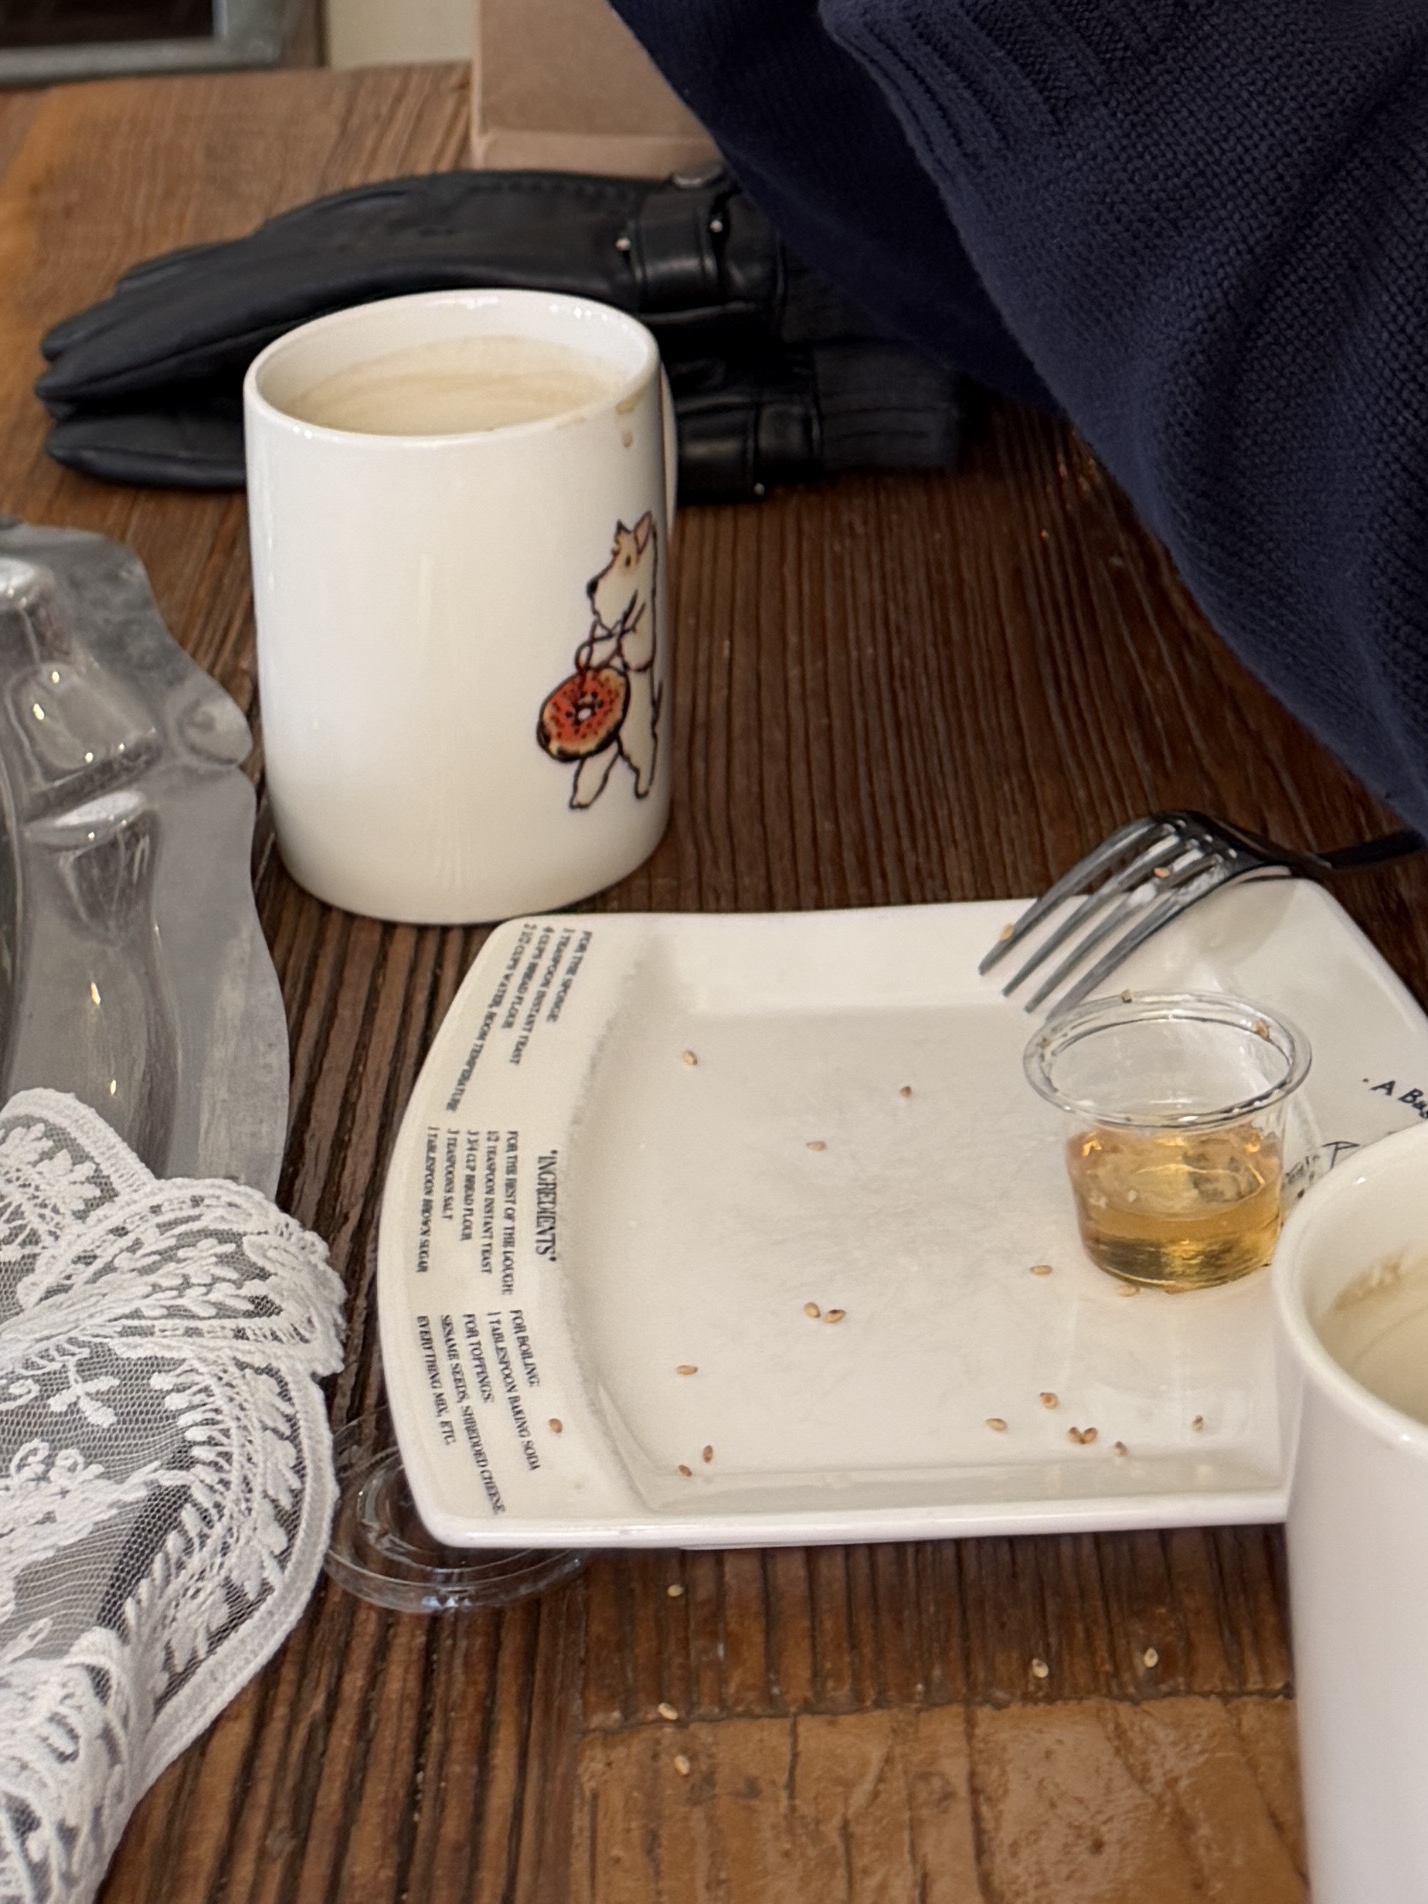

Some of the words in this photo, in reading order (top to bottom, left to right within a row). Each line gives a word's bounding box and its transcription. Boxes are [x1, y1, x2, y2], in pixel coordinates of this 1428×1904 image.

[574, 930, 592, 953] FOR
[565, 956, 583, 976] THE
[506, 1130, 519, 1153] FOR
[465, 1153, 477, 1172] CUP
[484, 1145, 497, 1195] TEASPOON
[505, 1154, 518, 1175] THE
[463, 1174, 476, 1206] BREAD
[441, 1195, 454, 1220] SALT
[481, 1197, 495, 1239] INSTANT
[460, 1207, 474, 1241] FLOUR
[503, 1226, 516, 1248] THE
[416, 1239, 430, 1273] SUGAR
[480, 1242, 493, 1273] YEAST
[463, 1314, 479, 1338] FOR
[509, 1309, 527, 1335] FOR
[417, 1315, 442, 1389] EVERYTHING
[440, 1314, 460, 1361] SESAME
[461, 1405, 488, 1468] SHREDDED
[488, 1319, 518, 1393] TABLESPOON
[508, 1395, 531, 1438] BAKING
[522, 1439, 541, 1471] SODA
